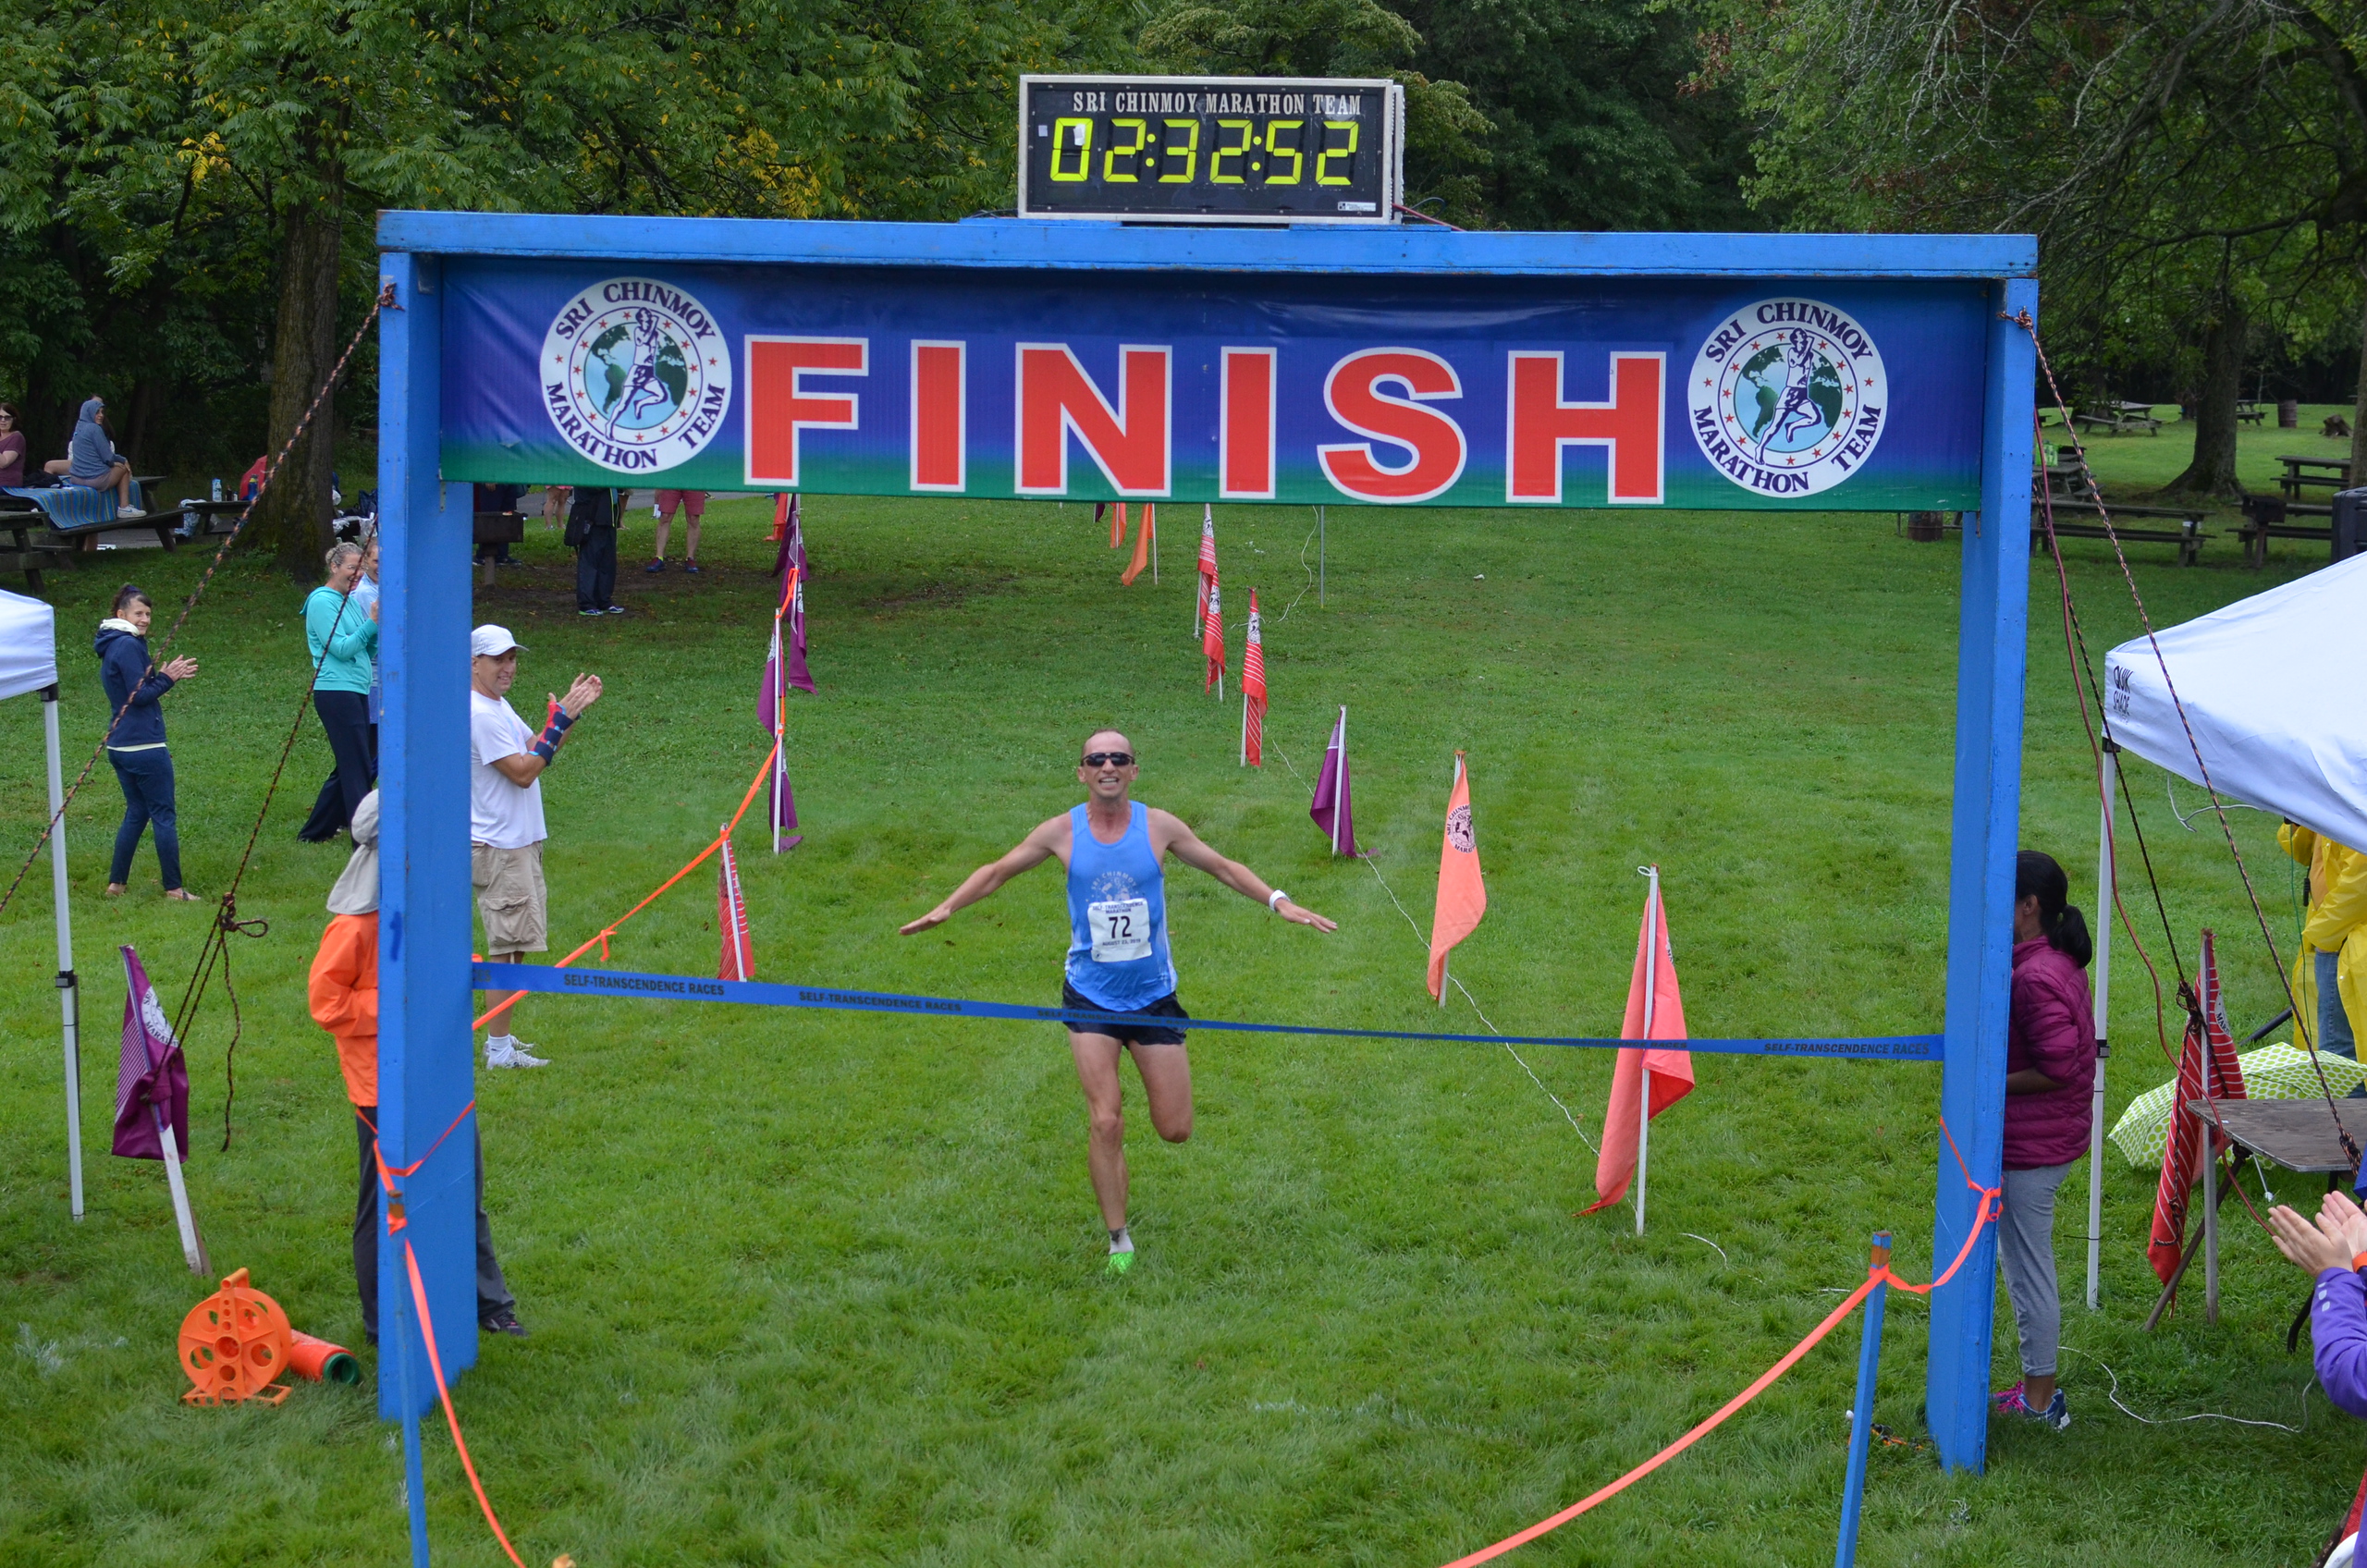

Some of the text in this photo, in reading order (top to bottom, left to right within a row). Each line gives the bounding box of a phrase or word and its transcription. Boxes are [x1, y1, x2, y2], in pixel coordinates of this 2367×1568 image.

[1073, 92, 1361, 115] SRI CHINMOY MARATHON TEAM
[1049, 117, 1359, 185] 02:32:52
[556, 281, 717, 340] SRI CHINMOY
[1706, 301, 1873, 363] SRI CHINMOY
[546, 381, 726, 470] MARATHON TEAM
[743, 334, 1666, 504] FINISH
[1694, 404, 1882, 494] MARATHON TEAM
[1101, 870, 1137, 887] CHINMOY
[1109, 915, 1132, 938] 72
[564, 974, 725, 996] SELF-TRANSCENDENCE RACES
[799, 991, 962, 1011] SELF-TRANSCENDENCE RACES
[1764, 1043, 1930, 1055] SELF-TRANSCENDENCE RACES
